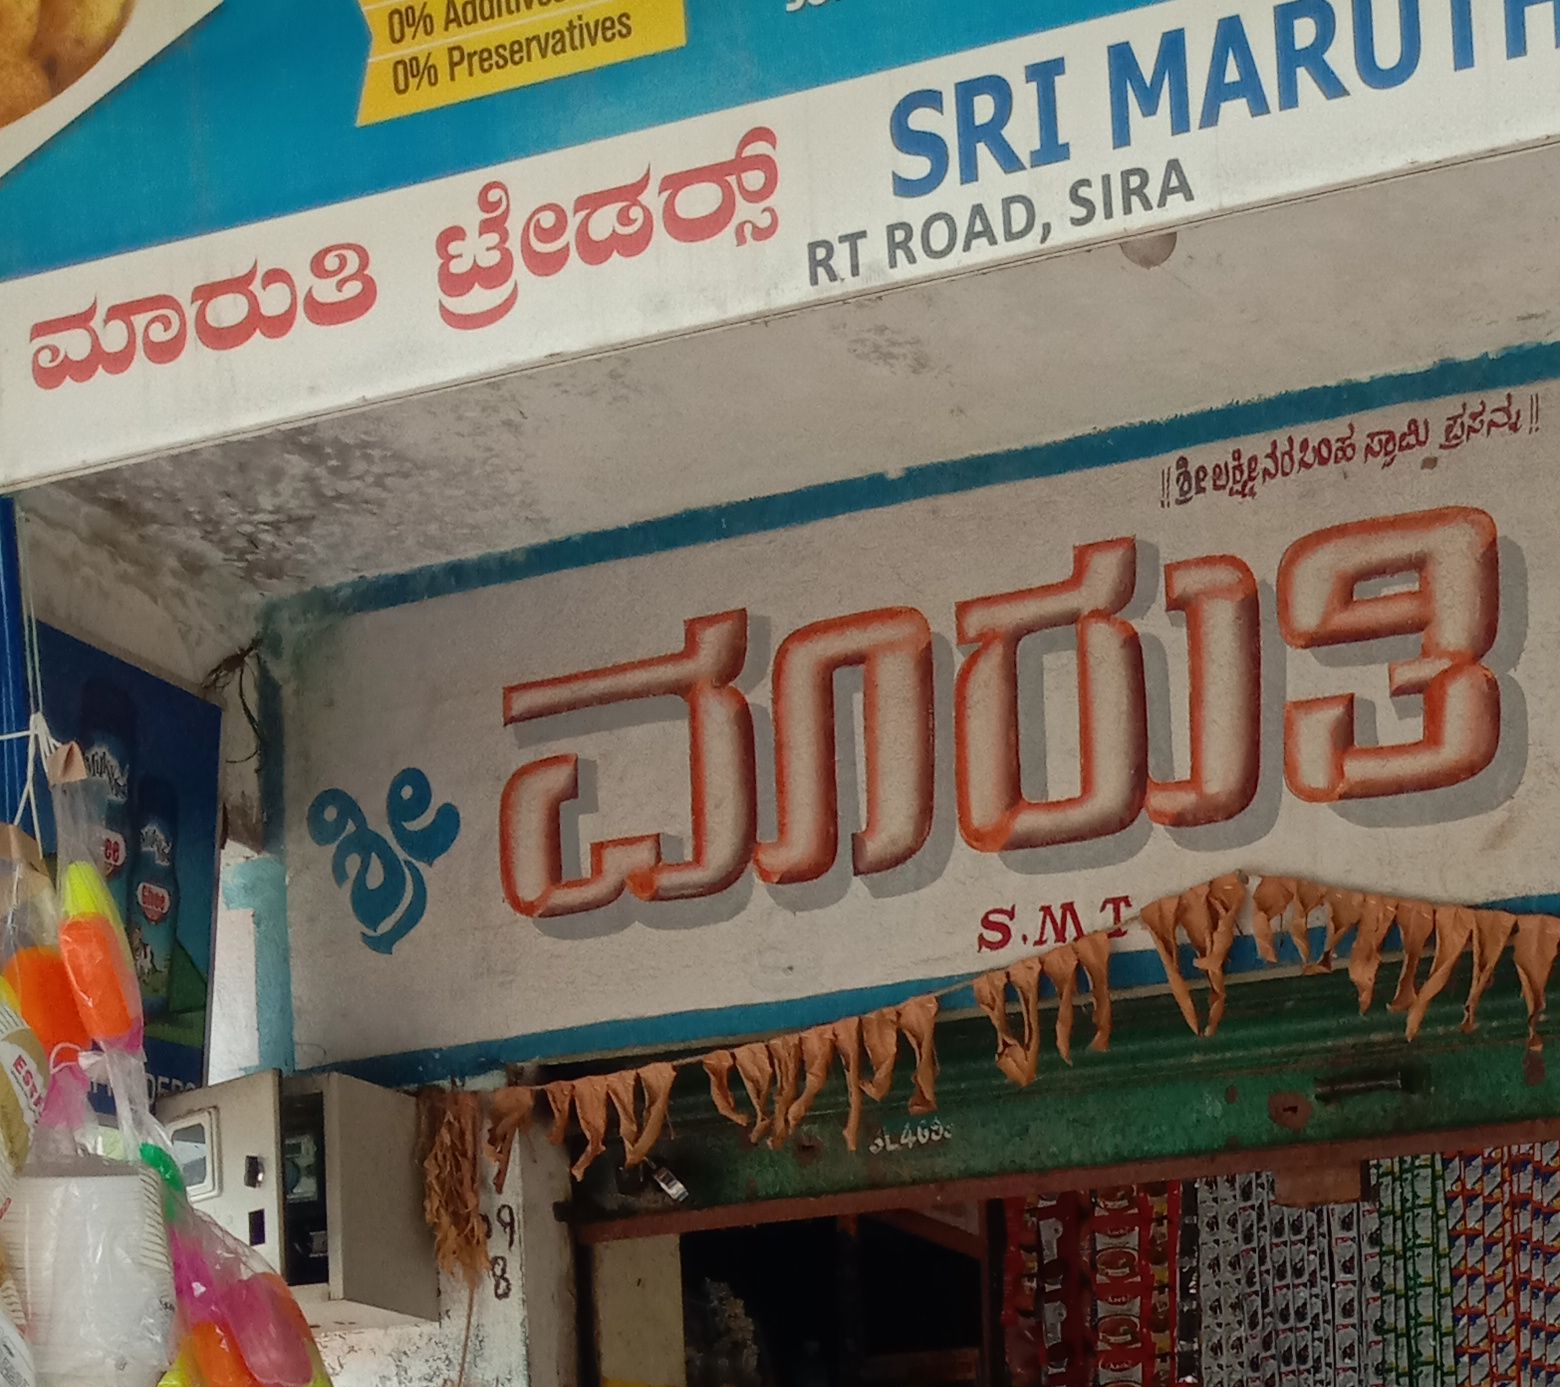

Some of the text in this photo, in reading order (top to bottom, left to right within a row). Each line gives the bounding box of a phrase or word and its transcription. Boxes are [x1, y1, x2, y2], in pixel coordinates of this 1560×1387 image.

[388, 0, 567, 44] 0% Addit
[393, 11, 633, 95] 0% Preservatives
[890, 60, 1071, 200] SRI
[29, 126, 780, 391] ಮಾರುತಿ ಟ್ರೇಡರ್ಸ್
[806, 157, 1196, 289] RT ROAD, SIRA
[308, 766, 461, 957] ಶ್ರೀ
[501, 505, 1505, 922] ಮಾರುತಿ
